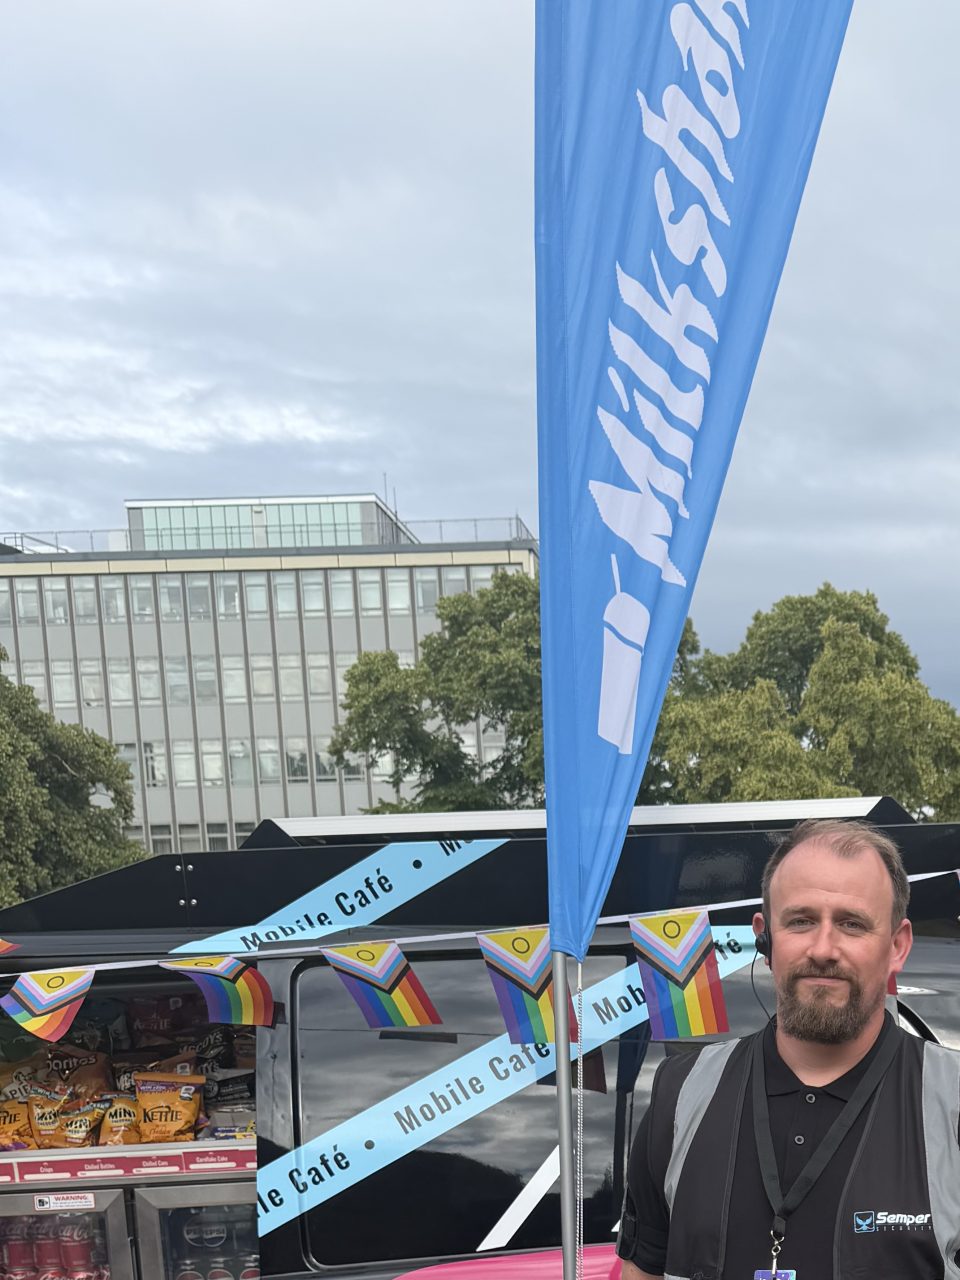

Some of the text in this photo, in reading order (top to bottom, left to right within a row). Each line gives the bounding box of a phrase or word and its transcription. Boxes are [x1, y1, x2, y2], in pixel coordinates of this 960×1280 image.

[240, 867, 394, 951] Mobile Café
[288, 1144, 351, 1195] Café
[393, 1075, 485, 1135] Mobile
[592, 984, 645, 1025] Mob
[876, 1212, 931, 1226] Semper
